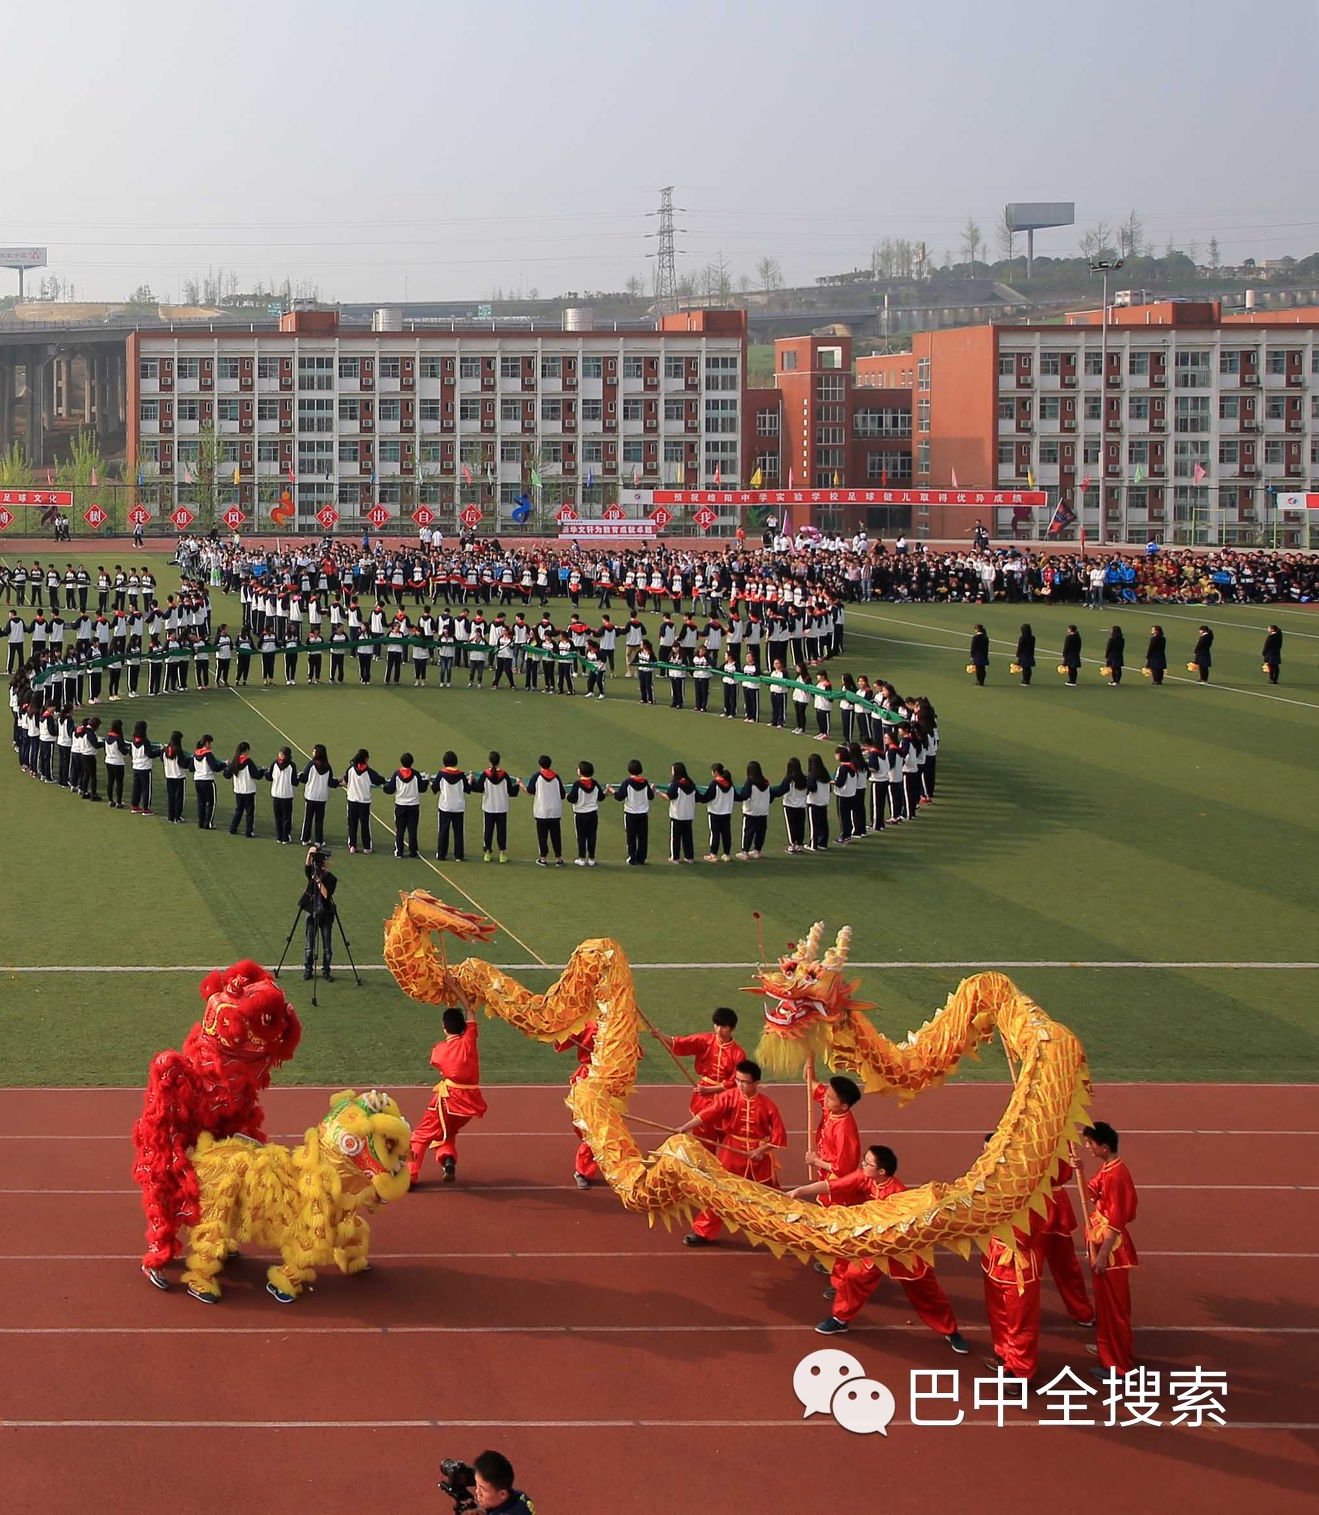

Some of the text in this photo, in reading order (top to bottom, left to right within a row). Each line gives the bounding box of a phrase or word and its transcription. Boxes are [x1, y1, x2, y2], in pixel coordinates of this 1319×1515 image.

[674, 492, 1023, 503] 预祝绵阳中学实验学校足球健儿取得优异成绩
[373, 510, 385, 522] 出
[418, 510, 429, 523] 自
[465, 510, 477, 522] 信
[656, 511, 666, 524] 自
[699, 511, 711, 524] 我
